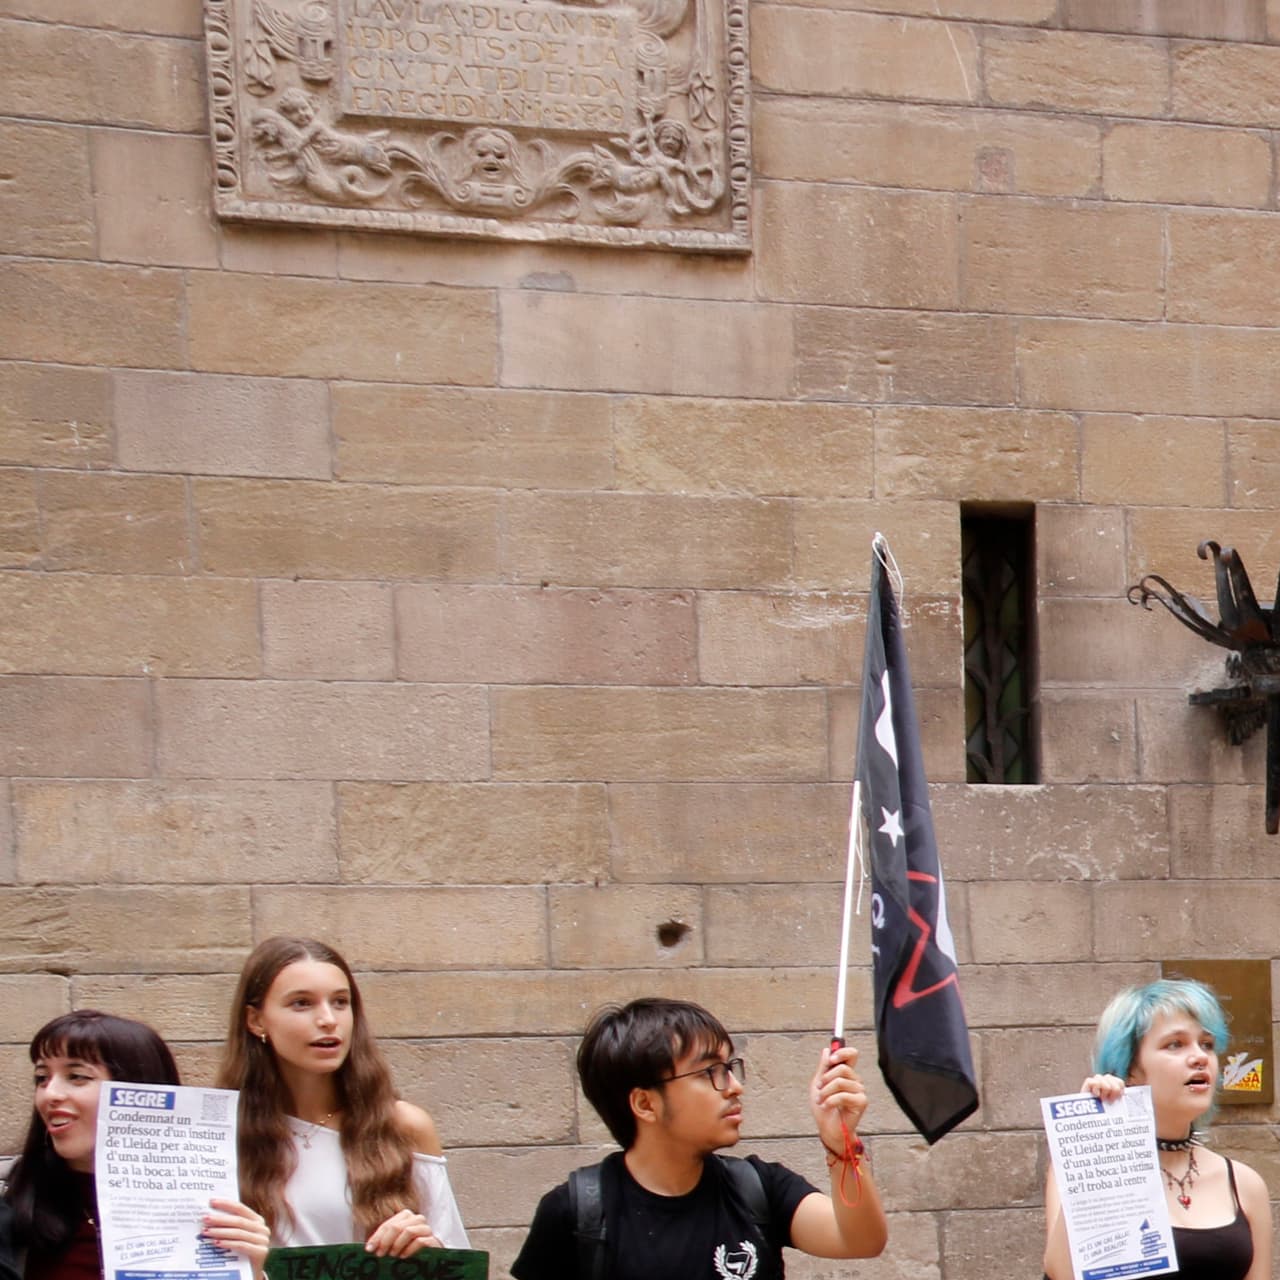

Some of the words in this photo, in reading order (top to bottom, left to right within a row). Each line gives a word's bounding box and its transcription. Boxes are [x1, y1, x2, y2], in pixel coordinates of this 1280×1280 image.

[113, 1089, 167, 1108] SEGRE
[1056, 1099, 1098, 1118] SEGRE
[109, 1110, 174, 1124] Condemnat
[177, 1115, 191, 1125] un
[1055, 1117, 1111, 1132] Condemnat
[1112, 1117, 1123, 1125] un
[107, 1123, 162, 1137] professor
[163, 1126, 187, 1138] d'un
[189, 1127, 225, 1140] institut
[1058, 1131, 1104, 1147] professor
[1106, 1128, 1123, 1138] d'un
[105, 1136, 119, 1148] de
[122, 1137, 158, 1150] Lleida
[160, 1141, 179, 1153] per
[183, 1140, 217, 1153] abusar
[1061, 1147, 1073, 1157] de
[1074, 1143, 1104, 1155] Lleida
[1105, 1142, 1119, 1153] per
[1121, 1138, 1145, 1149] abusar
[106, 1150, 139, 1162] d'una
[142, 1152, 187, 1164] alumna
[189, 1153, 199, 1164] al
[1063, 1159, 1091, 1170] d'una
[1093, 1154, 1125, 1166] alumna
[1127, 1150, 1134, 1160] al
[107, 1163, 119, 1175] la
[121, 1166, 128, 1175] a
[131, 1164, 142, 1176] la
[144, 1165, 175, 1177] boca:
[178, 1165, 188, 1177] la
[1065, 1172, 1075, 1182] la
[1077, 1172, 1084, 1180] a
[1085, 1168, 1094, 1179] la
[1095, 1167, 1119, 1178] boca:
[1120, 1164, 1128, 1174] la
[108, 1177, 130, 1188] se'l
[132, 1179, 163, 1190] troba
[166, 1179, 177, 1190] al
[180, 1181, 215, 1191] centre
[1068, 1182, 1085, 1194] se'l
[1087, 1179, 1113, 1192] troba
[1114, 1176, 1122, 1187] al
[1123, 1176, 1147, 1186] centre
